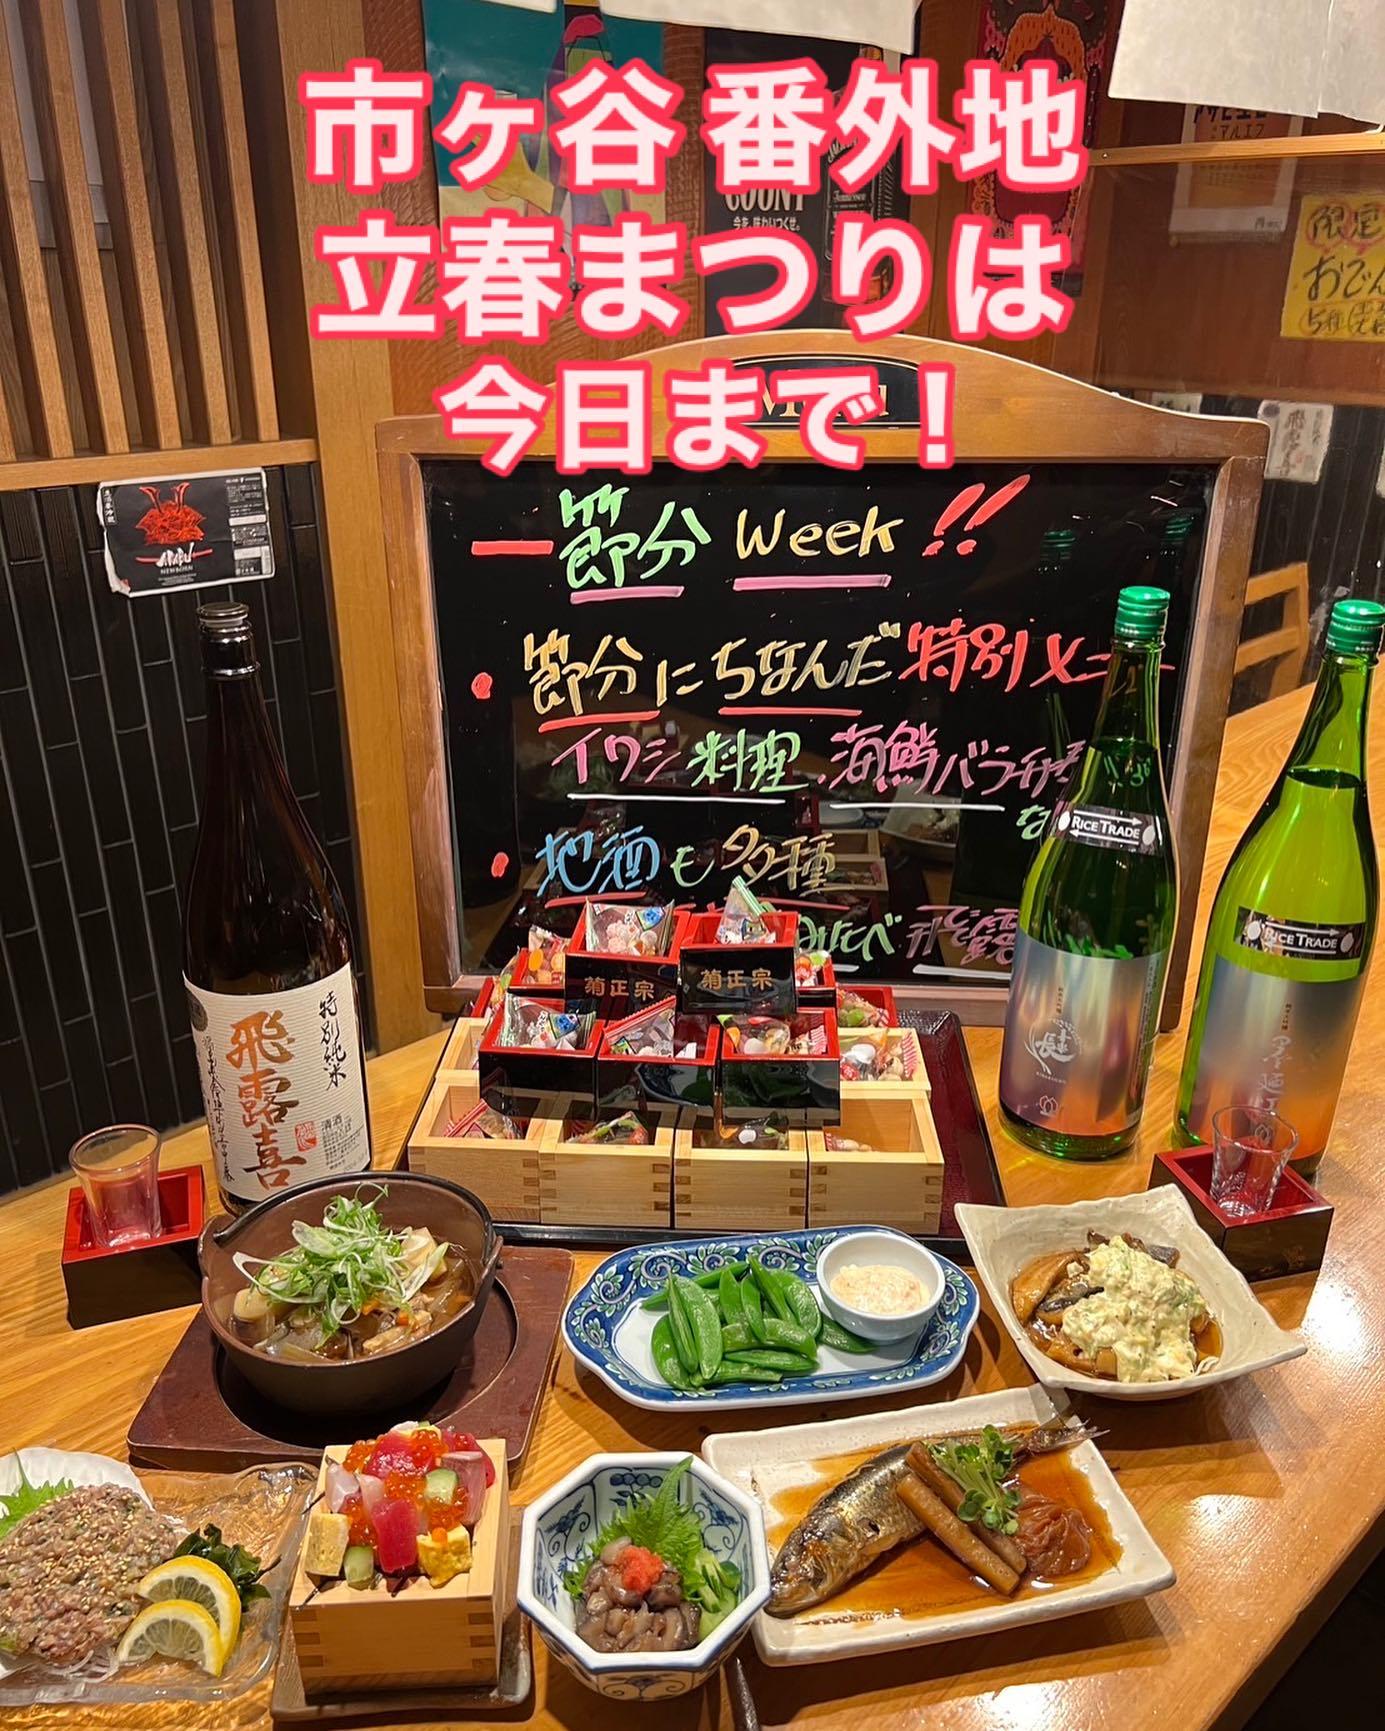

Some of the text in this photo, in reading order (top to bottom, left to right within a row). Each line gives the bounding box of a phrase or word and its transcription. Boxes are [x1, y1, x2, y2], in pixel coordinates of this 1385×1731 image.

[559, 483, 712, 588] 節分
[736, 506, 904, 559] Week
[1071, 815, 1140, 839] RICE TRADE
[1264, 927, 1338, 949] RICE TRADE
[584, 976, 655, 1001] 菊正宗
[700, 967, 773, 991] 菊正宗
[318, 990, 347, 1091] 特別純米
[226, 1009, 307, 1191] 飛露喜
